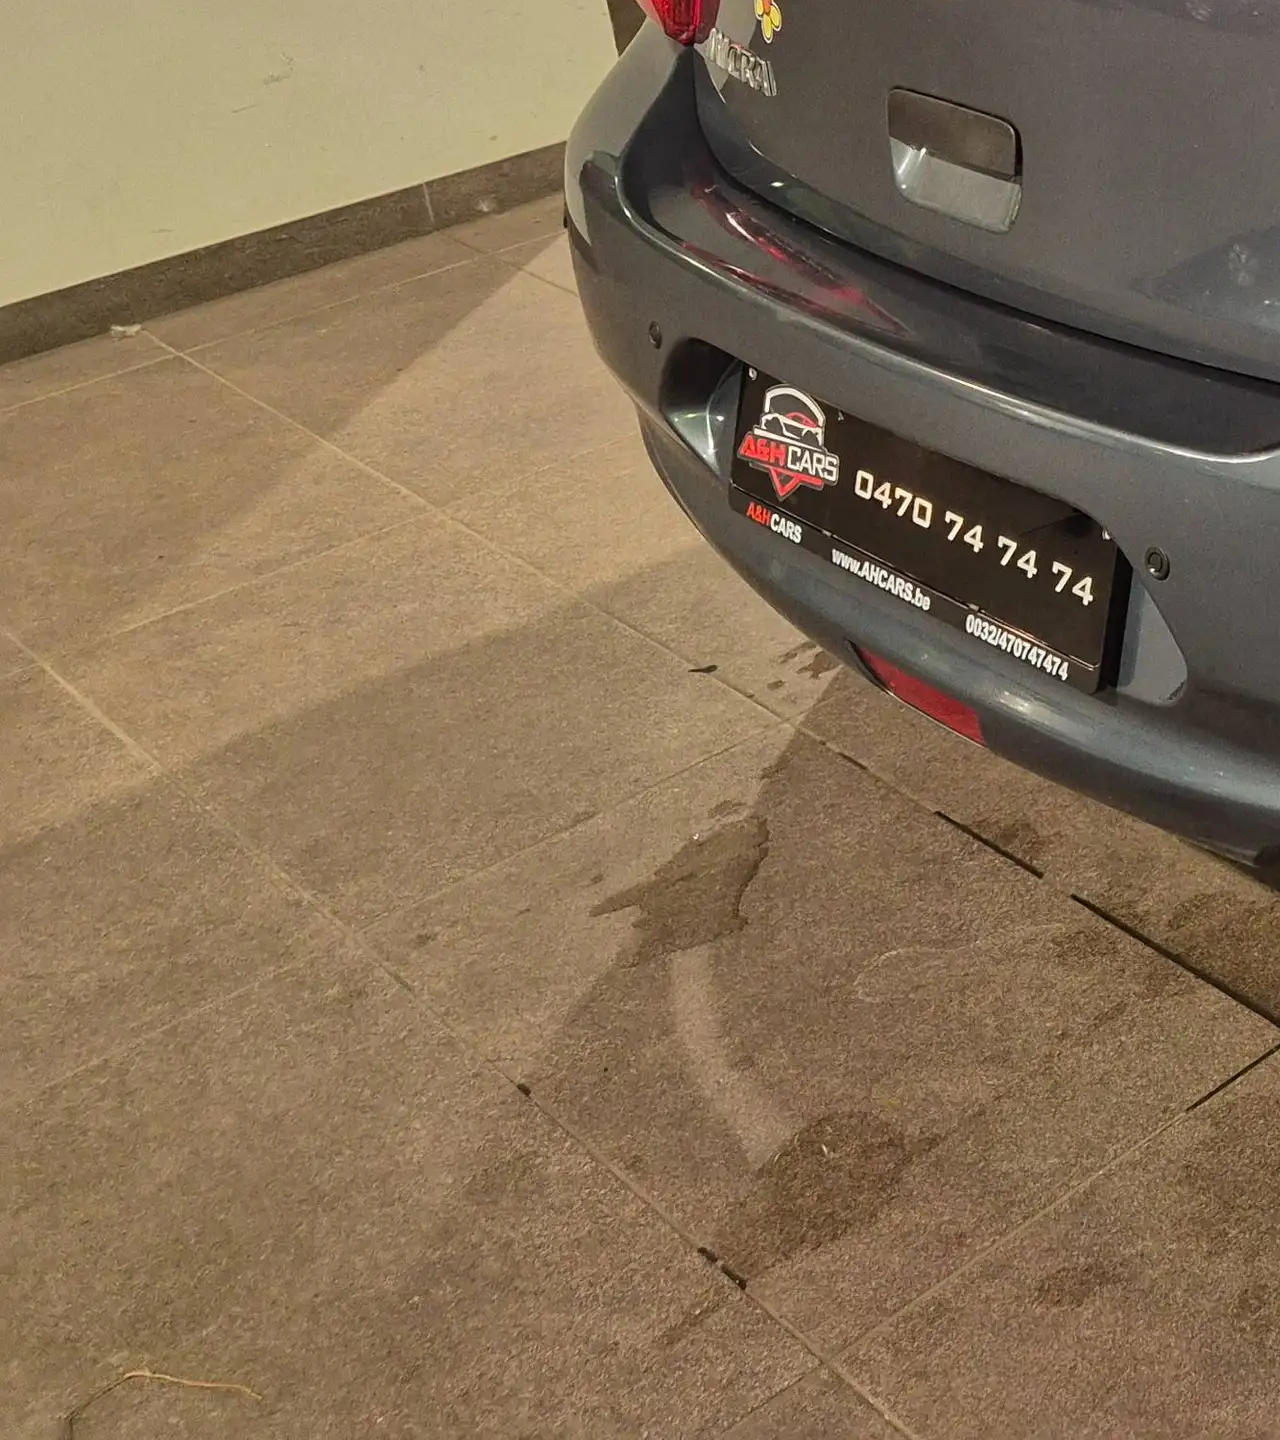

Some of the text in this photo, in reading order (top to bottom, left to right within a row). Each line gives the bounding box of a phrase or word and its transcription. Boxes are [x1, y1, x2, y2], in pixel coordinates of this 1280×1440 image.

[855, 470, 1095, 607] 0470 74 74 74
[832, 549, 930, 610] www.AHCARS.be
[966, 614, 1069, 681] 0032/470747474
